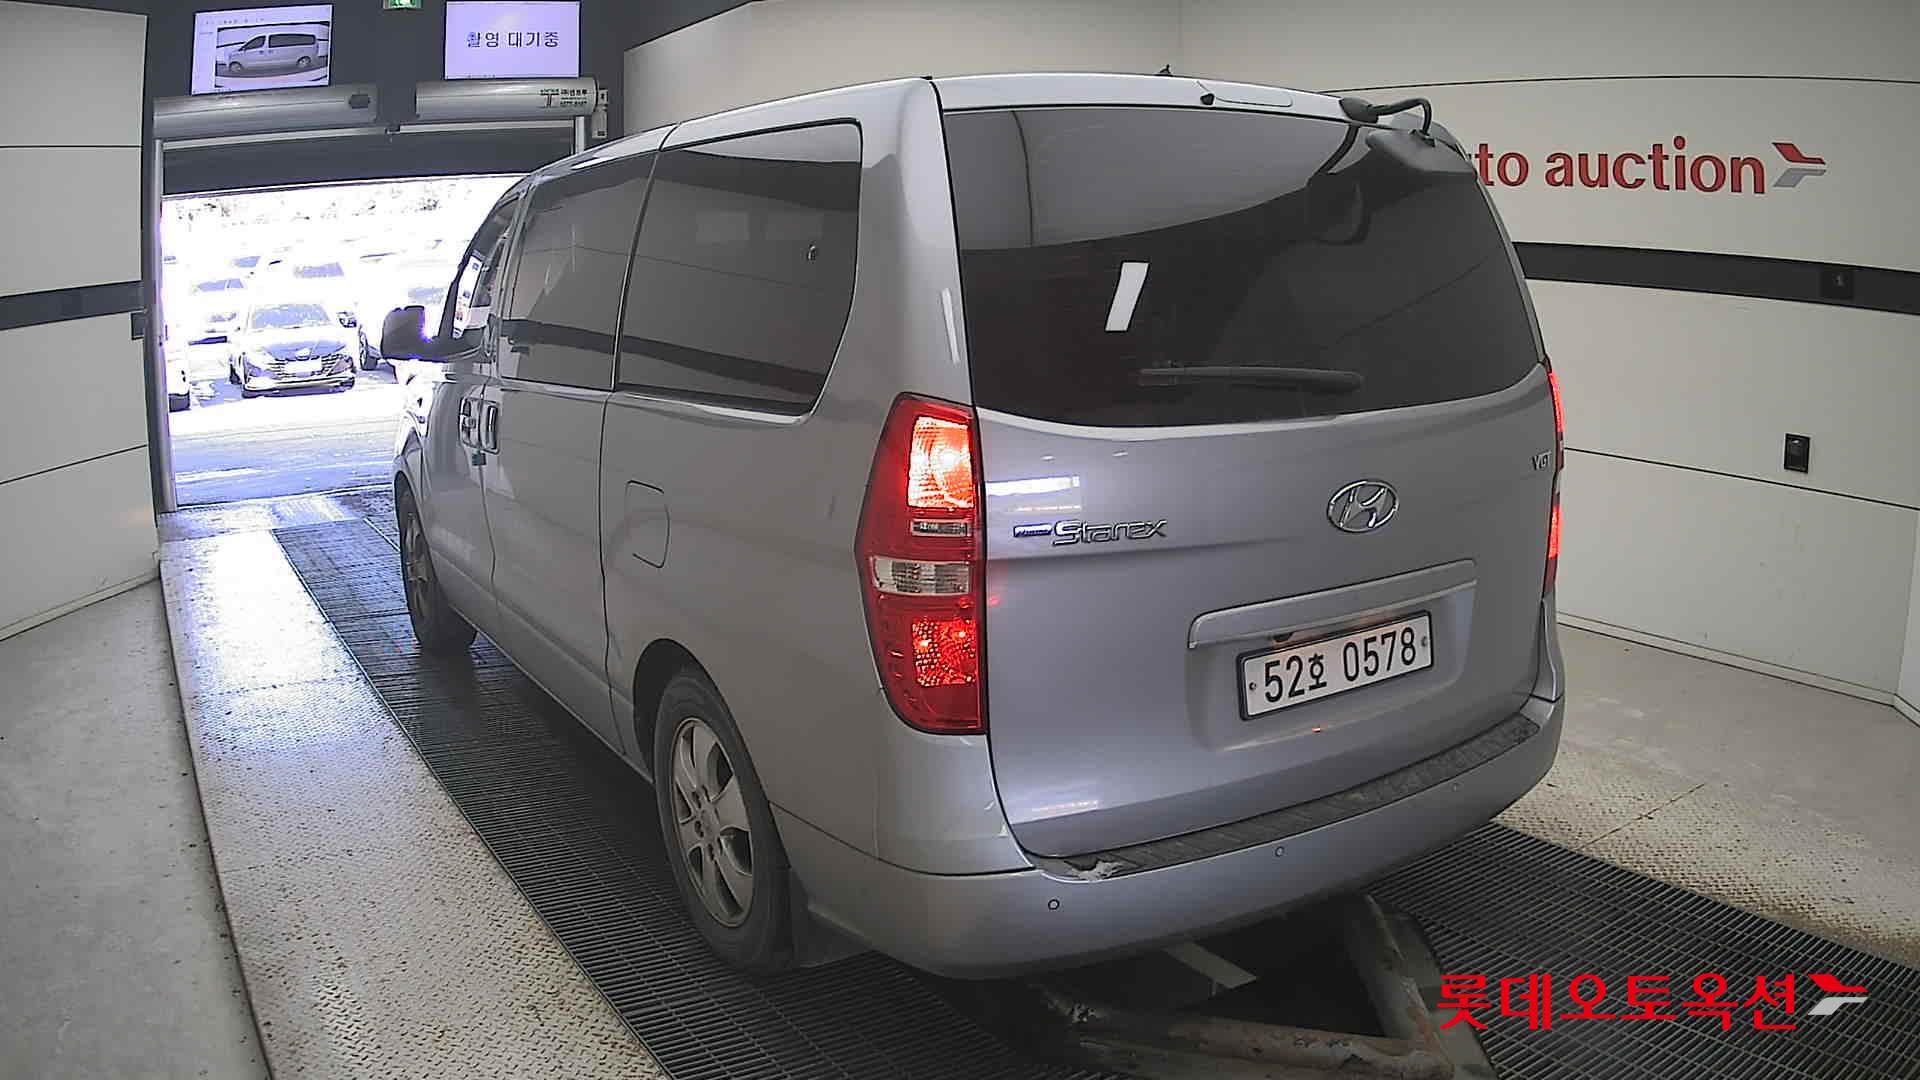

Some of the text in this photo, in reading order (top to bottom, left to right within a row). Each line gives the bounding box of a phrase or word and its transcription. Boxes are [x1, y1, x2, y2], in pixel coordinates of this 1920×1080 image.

[508, 32, 559, 48] 대기중
[1469, 136, 1766, 194] to auction
[1052, 519, 1168, 546] Starex
[1264, 627, 1416, 703] 52호 0578
